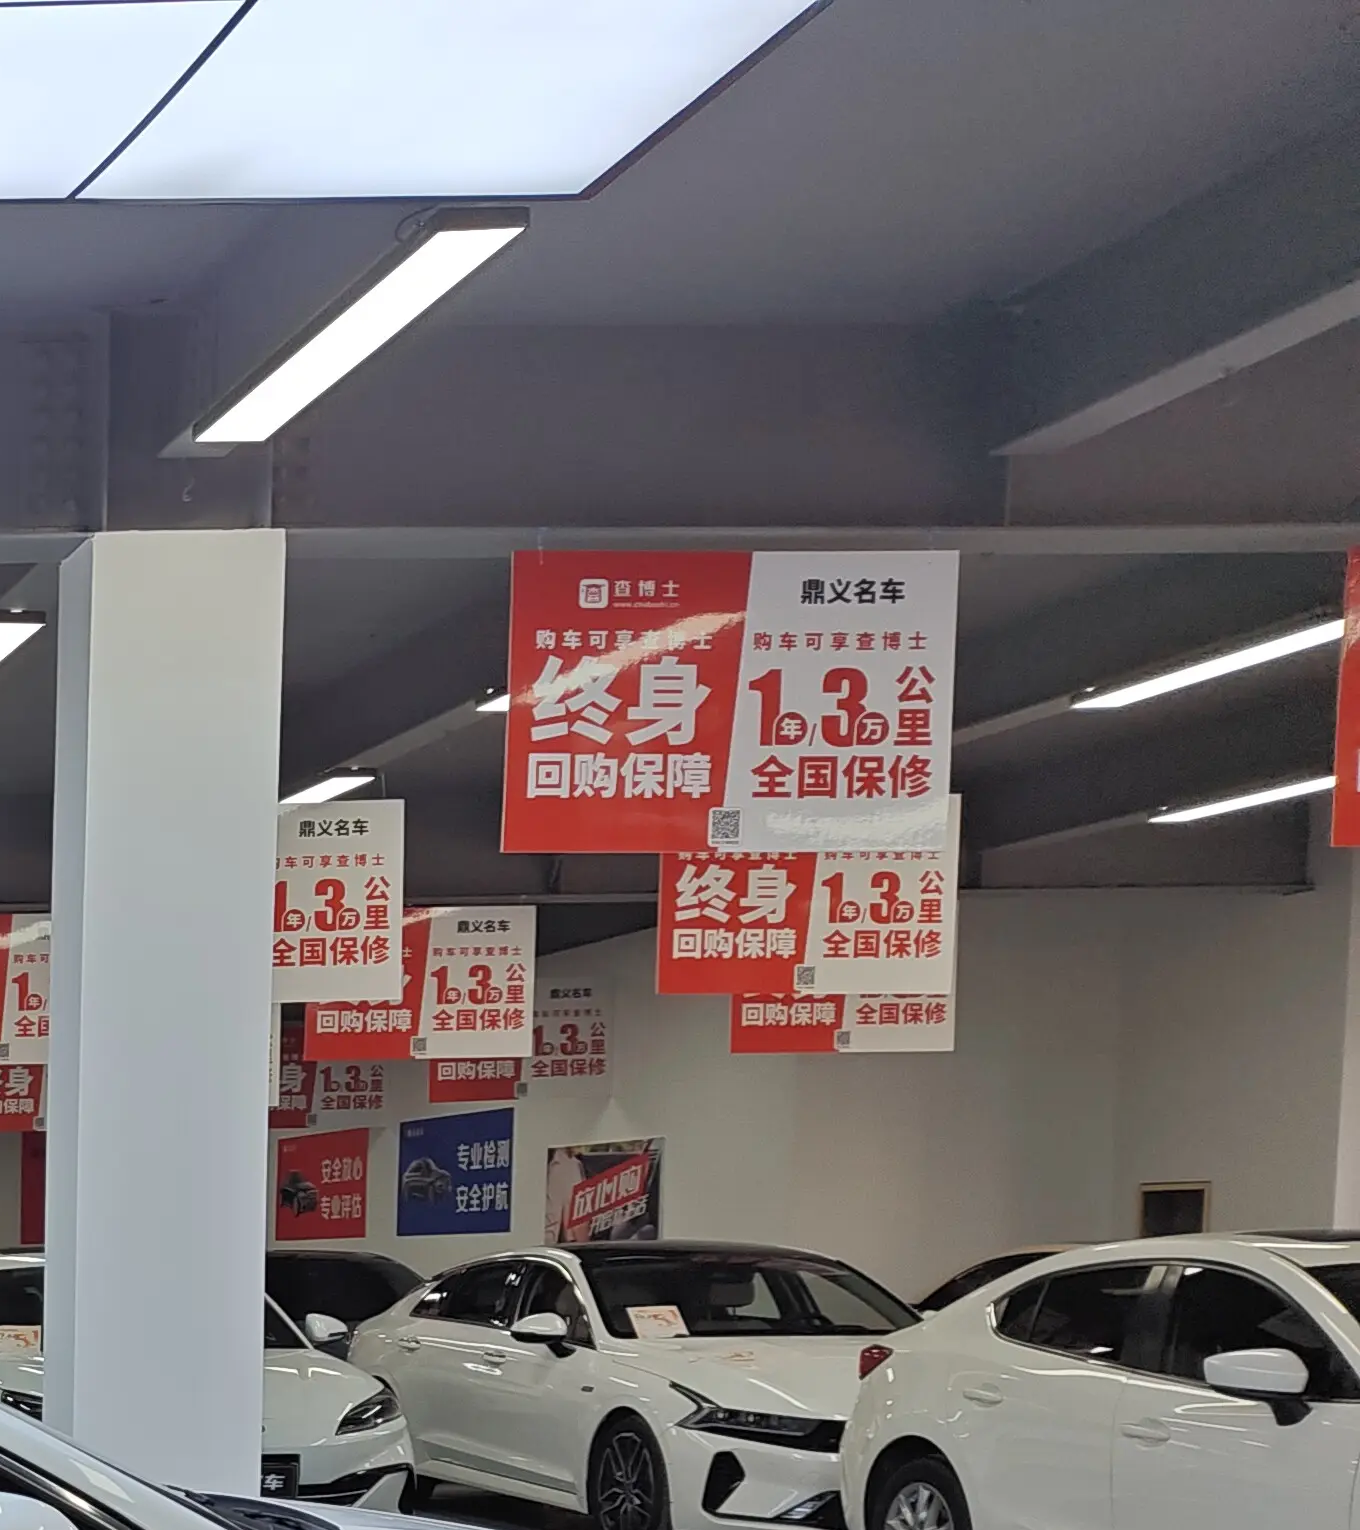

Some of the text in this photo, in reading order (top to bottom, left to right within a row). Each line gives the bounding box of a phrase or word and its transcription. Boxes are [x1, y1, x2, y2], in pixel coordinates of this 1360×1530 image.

[613, 580, 680, 597] 查博士
[800, 578, 906, 605] 鼎义名车
[535, 630, 713, 651] 购车可享查博士
[753, 632, 928, 652] 购车可享查博士
[530, 656, 712, 746] 终身
[527, 752, 712, 800] 回购保障
[751, 754, 933, 800] 全国保修
[299, 819, 369, 837] 鼎义名车
[275, 854, 385, 870] 车可享查博士
[675, 864, 798, 924] 终身
[457, 919, 511, 933] 鼎义名车
[272, 936, 390, 967] 全国保修
[432, 946, 523, 958] 购车可享查博士
[672, 928, 797, 959] 回购保障
[822, 929, 942, 959] 全国保修
[316, 1010, 412, 1034] 回购保障
[432, 1009, 525, 1032] 全国保修
[741, 1003, 836, 1027] 回购保障
[855, 1003, 947, 1025] 全国保修
[438, 1061, 516, 1081] 回购保障
[531, 1060, 606, 1078] 全国保修
[321, 1095, 384, 1110] 全国保修
[457, 1139, 510, 1171] 专业检测
[456, 1182, 509, 1214] 安全护航
[572, 1165, 642, 1220] 放心购
[321, 1195, 362, 1220] 专业评估
